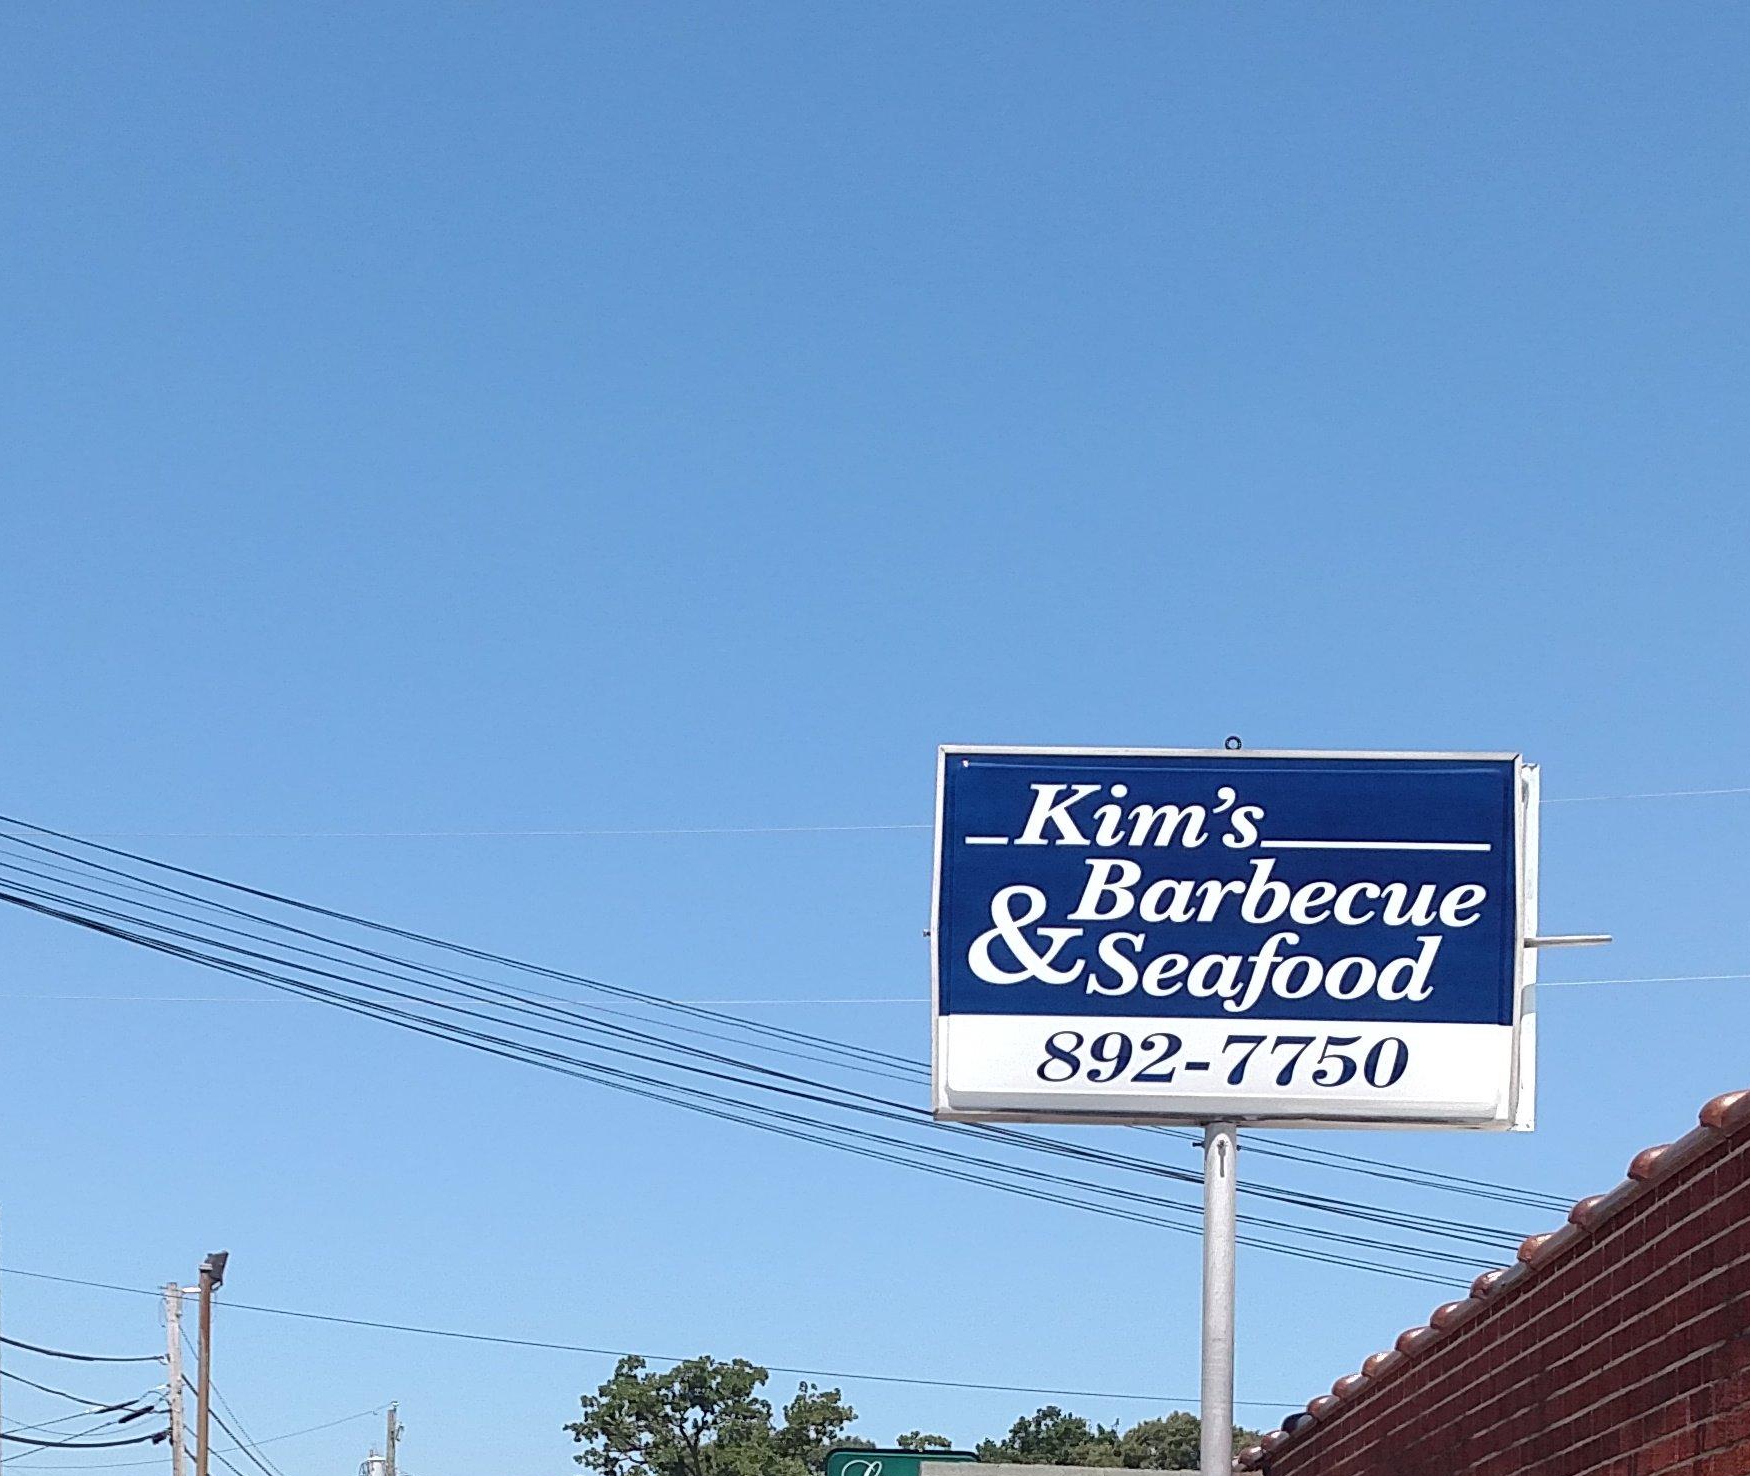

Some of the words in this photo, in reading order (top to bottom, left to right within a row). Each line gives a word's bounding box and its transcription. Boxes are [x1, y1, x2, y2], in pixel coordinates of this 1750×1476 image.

[1014, 783, 1265, 848] Kim's
[1067, 858, 1487, 927] Barbecue
[967, 884, 1087, 986] &
[1086, 931, 1442, 1013] Seafood
[1036, 1030, 1411, 1089] 892-7750
